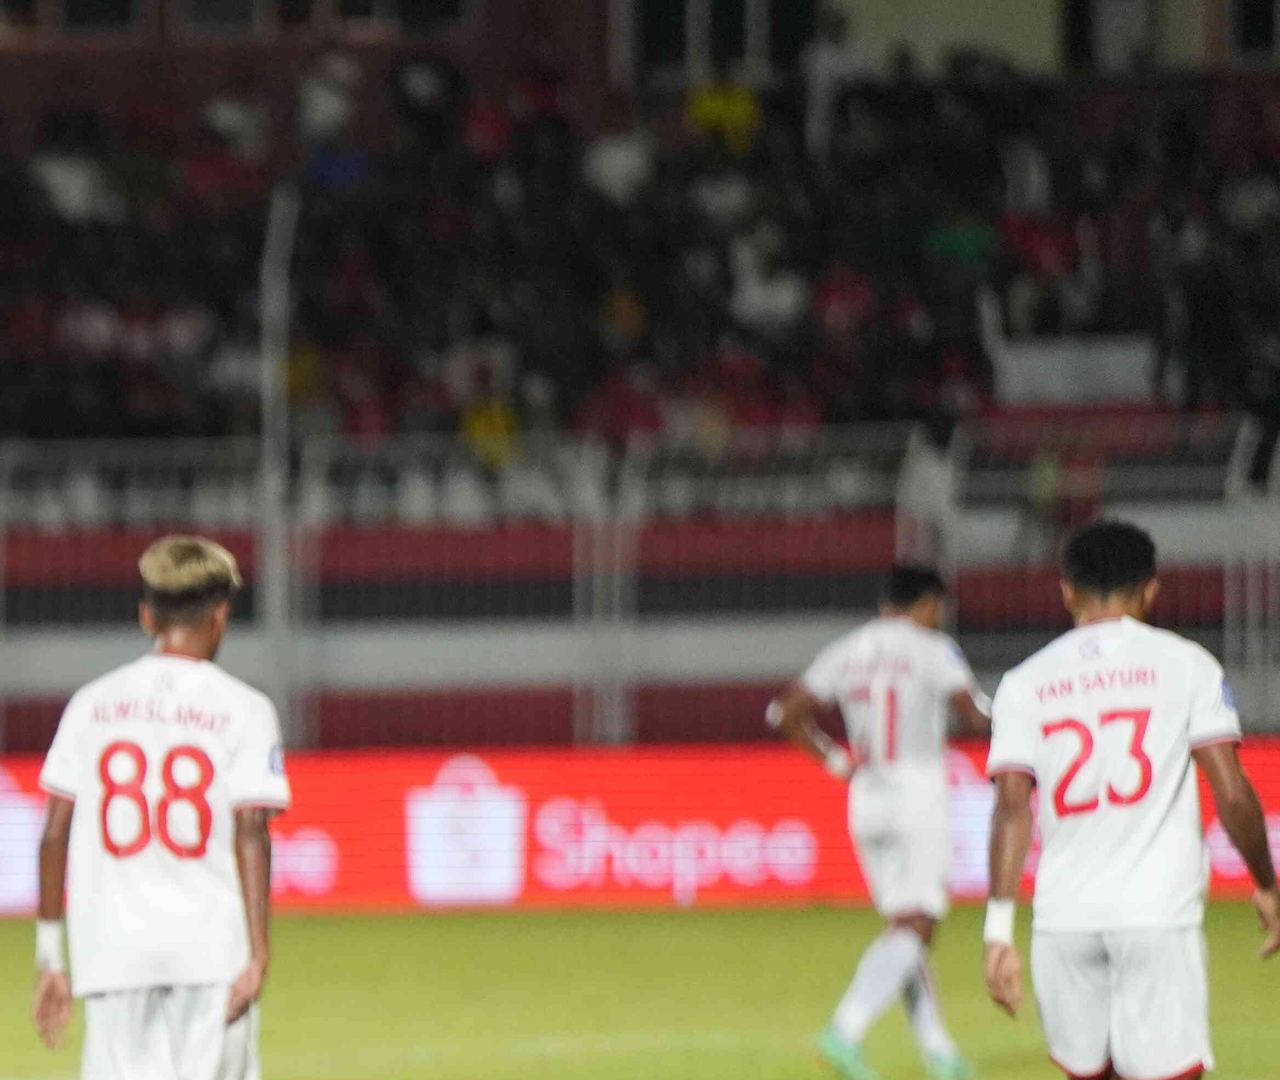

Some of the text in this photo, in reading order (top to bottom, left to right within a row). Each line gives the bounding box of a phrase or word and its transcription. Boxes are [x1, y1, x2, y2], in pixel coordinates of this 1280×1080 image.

[1035, 667, 1157, 702] YAN SAYURI
[98, 740, 216, 860] 88
[1042, 706, 1153, 819] 23
[534, 796, 819, 908] Shopee
